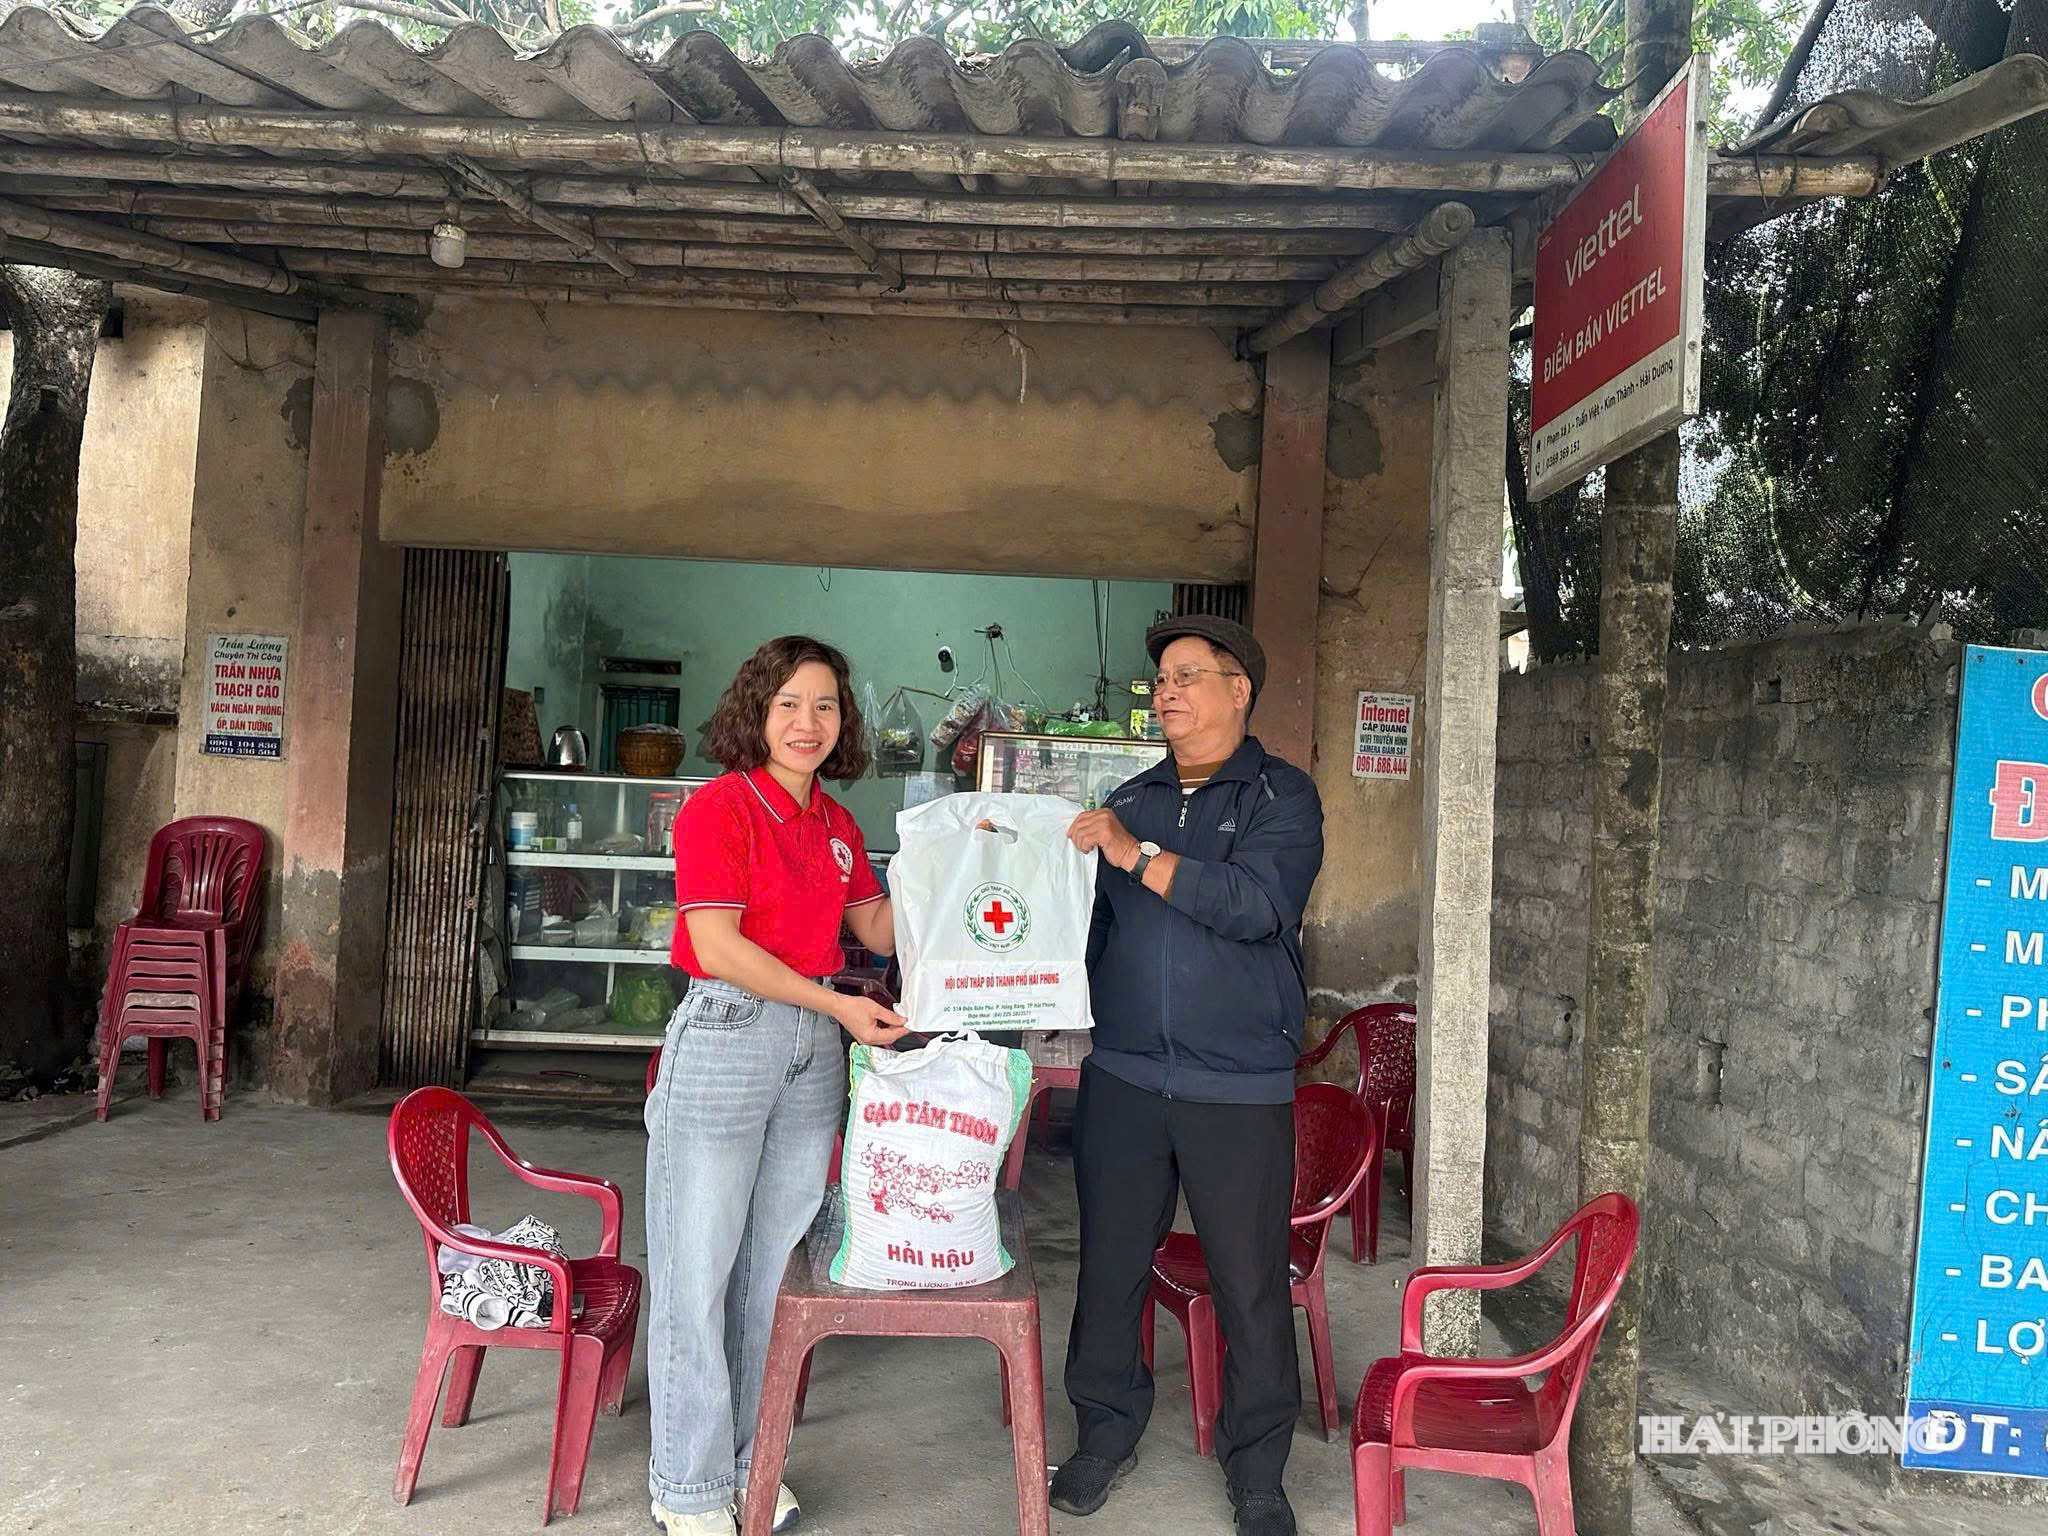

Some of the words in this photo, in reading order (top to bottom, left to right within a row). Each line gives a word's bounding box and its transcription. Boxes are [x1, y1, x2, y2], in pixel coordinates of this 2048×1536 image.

[1565, 183, 1643, 287] viettel
[1543, 332, 1573, 384] ĐIỂM
[1575, 314, 1602, 360] BÁN
[1606, 266, 1667, 335] VIETTEL
[1604, 396, 1616, 411] Kim
[1616, 382, 1635, 403] Thành
[214, 650, 244, 661] Chuyên
[247, 652, 259, 660] Thi
[261, 652, 283, 662] Công
[248, 665, 282, 684] NHỰA
[215, 682, 253, 700] THẠCH
[1361, 703, 1410, 724] Internet
[1362, 721, 1378, 732] CÁP
[1380, 723, 1407, 734] QUANG
[209, 746, 234, 754] 0979
[1359, 744, 1381, 754] CAMERA
[1395, 746, 1407, 755] SÁT
[1356, 755, 1408, 775] 0961.686.444
[2005, 930, 2048, 966] M
[970, 974, 985, 991] THẬP
[863, 1100, 902, 1129] GẠO
[949, 1110, 999, 1147] THƠM
[887, 1240, 924, 1267] HẢI
[931, 1249, 974, 1273] HẬU
